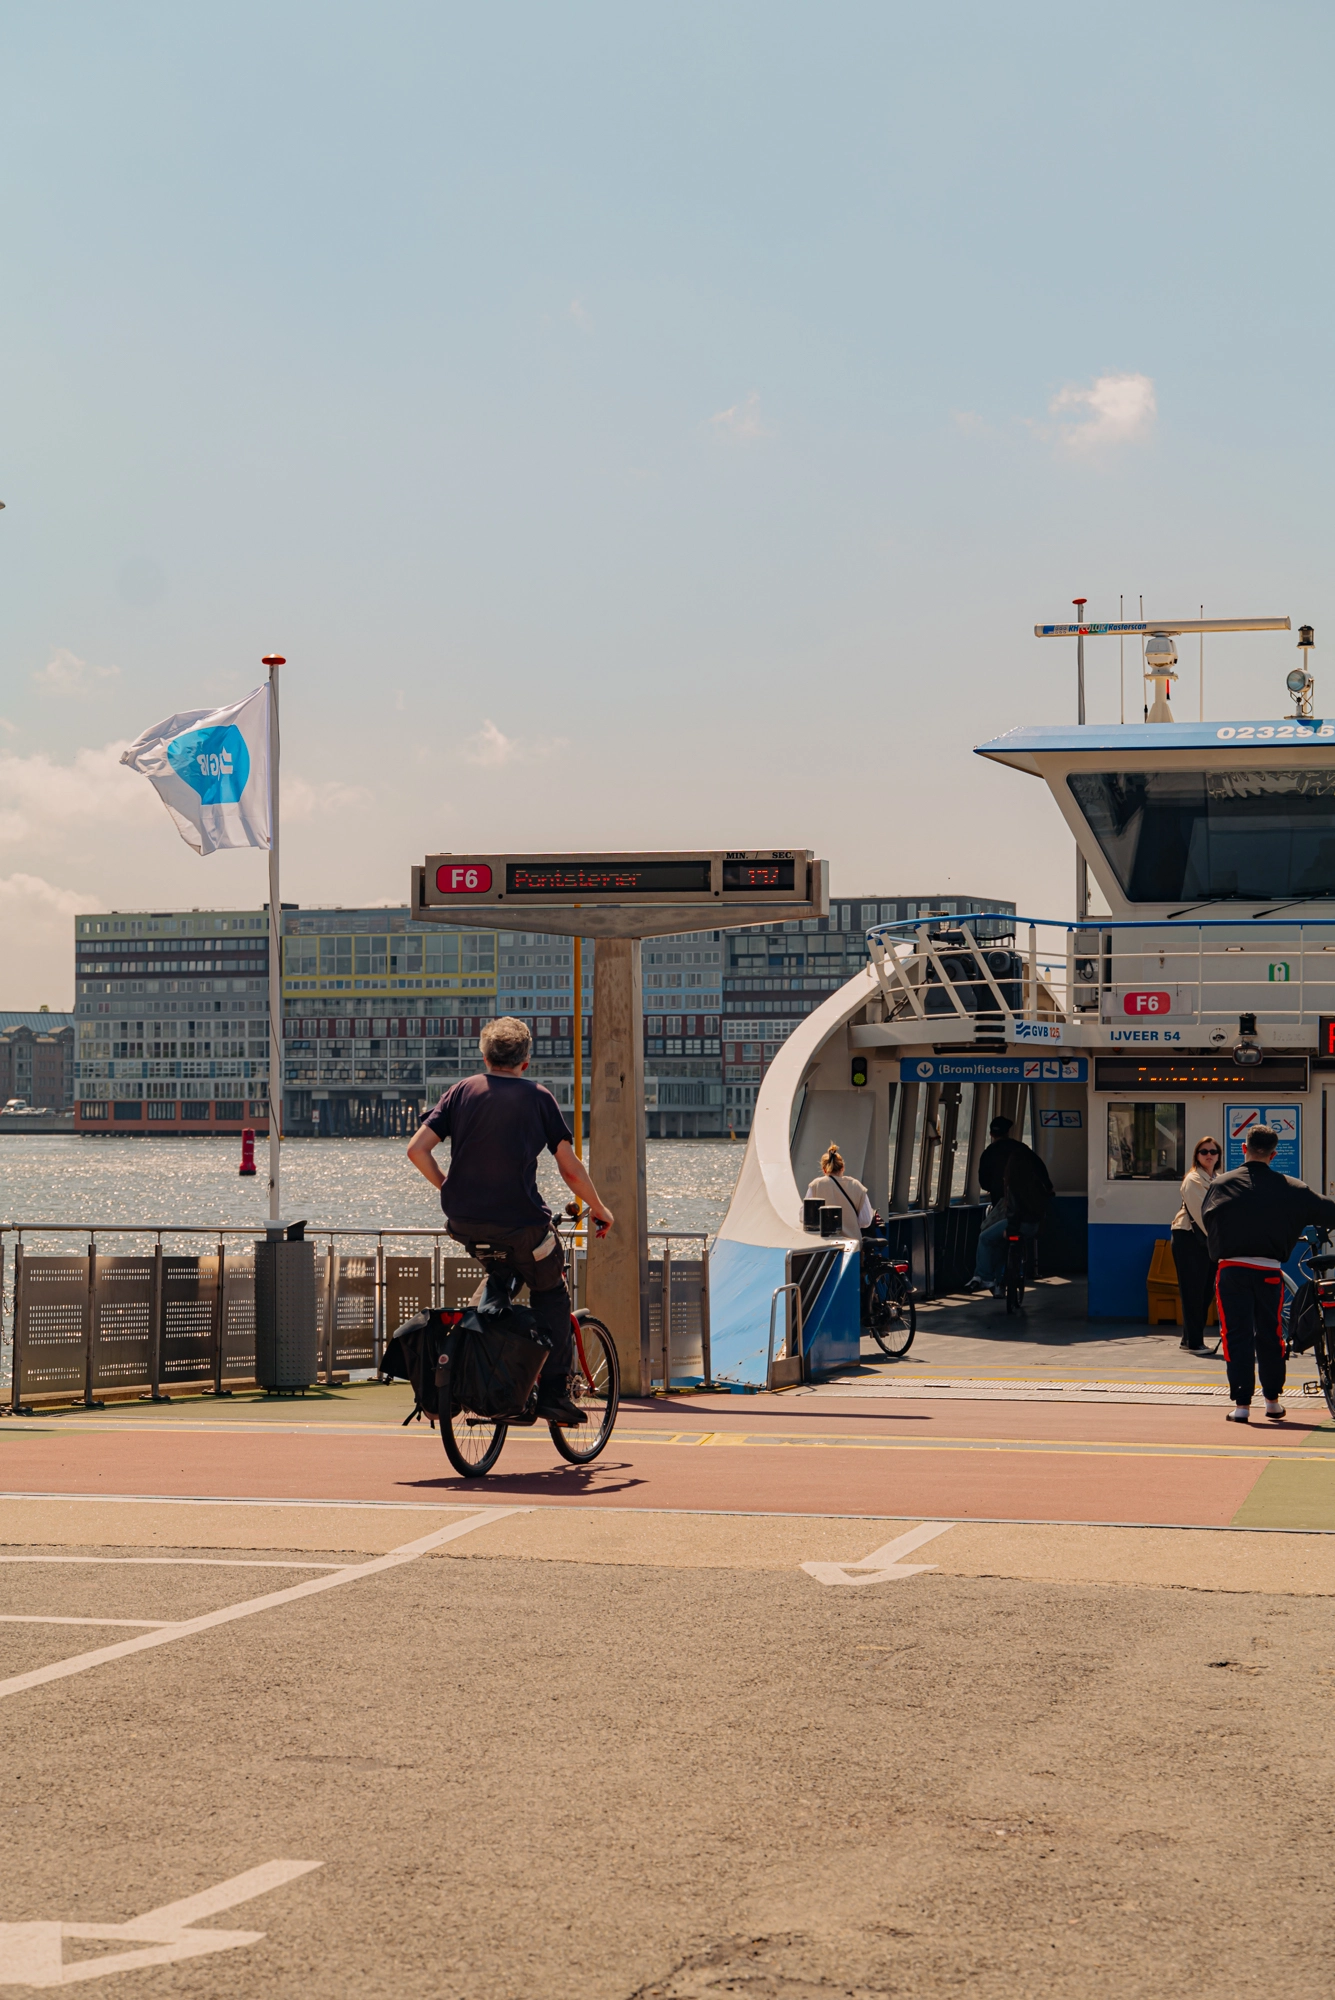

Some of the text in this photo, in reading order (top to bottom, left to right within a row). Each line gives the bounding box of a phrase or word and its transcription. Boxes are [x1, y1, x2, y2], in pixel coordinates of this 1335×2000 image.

[451, 869, 478, 888] F6
[1136, 996, 1159, 1011] F6
[1031, 1025, 1049, 1037] GVB
[1110, 1031, 1181, 1041] IJVEER 54
[938, 1064, 1020, 1075] (Brom)fietsers
